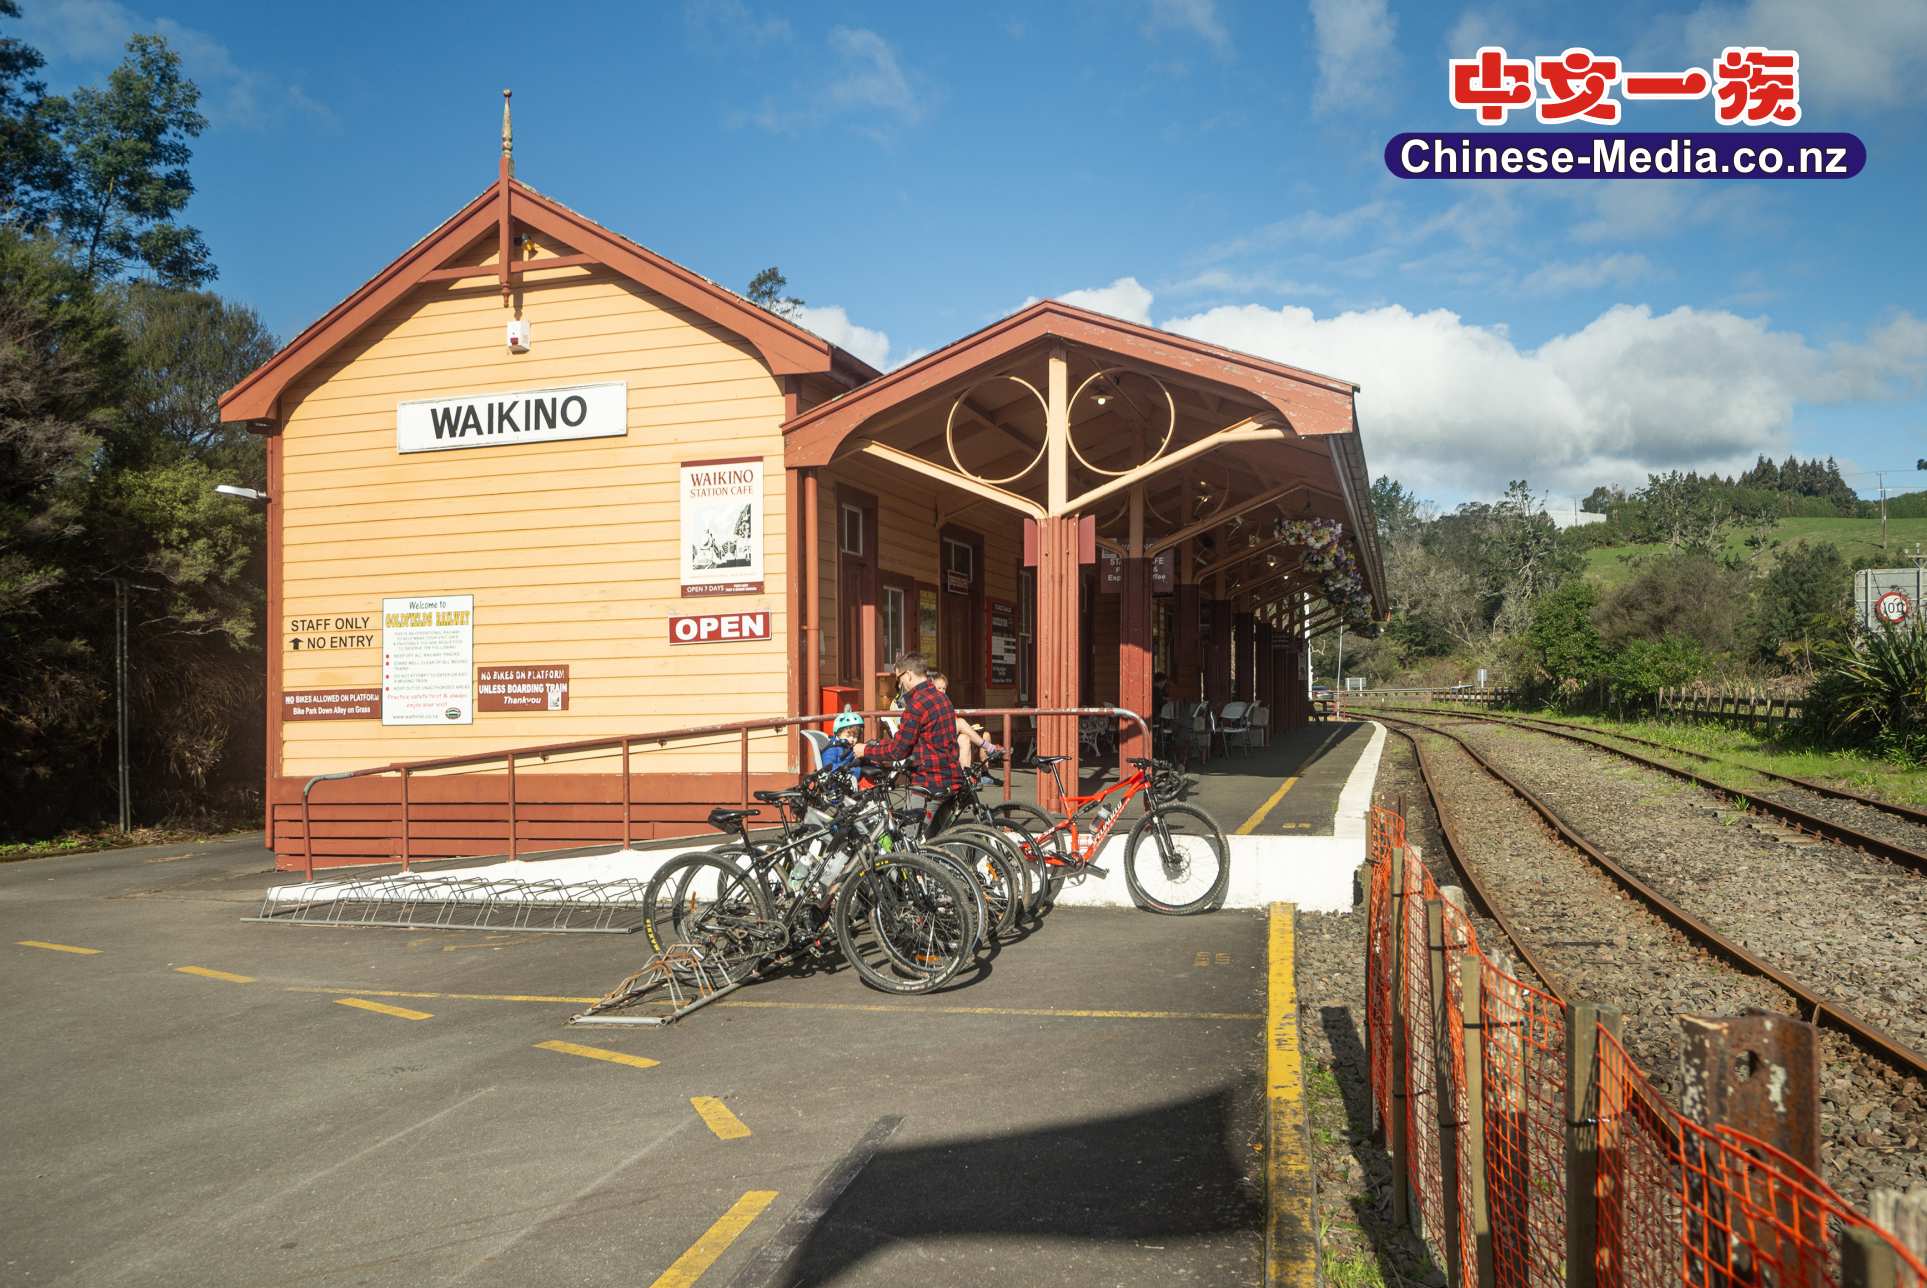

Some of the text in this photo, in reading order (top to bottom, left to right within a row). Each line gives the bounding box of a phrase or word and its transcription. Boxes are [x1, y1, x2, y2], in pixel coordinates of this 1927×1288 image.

[430, 395, 588, 440] WAIKINO
[690, 469, 754, 487] WAIKINO
[690, 487, 729, 498] STATION
[409, 600, 447, 610] Welcome to
[291, 616, 370, 632] STAFF ONLY
[675, 614, 765, 641] OPEN
[307, 635, 374, 649] NO ENTRY
[481, 670, 564, 681] NO BIKES ON PLATFORM
[479, 684, 506, 694] UNLESS
[507, 683, 544, 694] BOARDING
[546, 683, 568, 693] TRAIN
[285, 696, 295, 704] NO
[295, 695, 313, 703] BIKES
[313, 695, 340, 703] ALLOWED
[341, 694, 349, 702] ON
[293, 707, 304, 715] Bike
[305, 707, 318, 715] Park
[318, 706, 333, 714] Down
[334, 706, 347, 715] Alley
[355, 706, 371, 714] Grass
